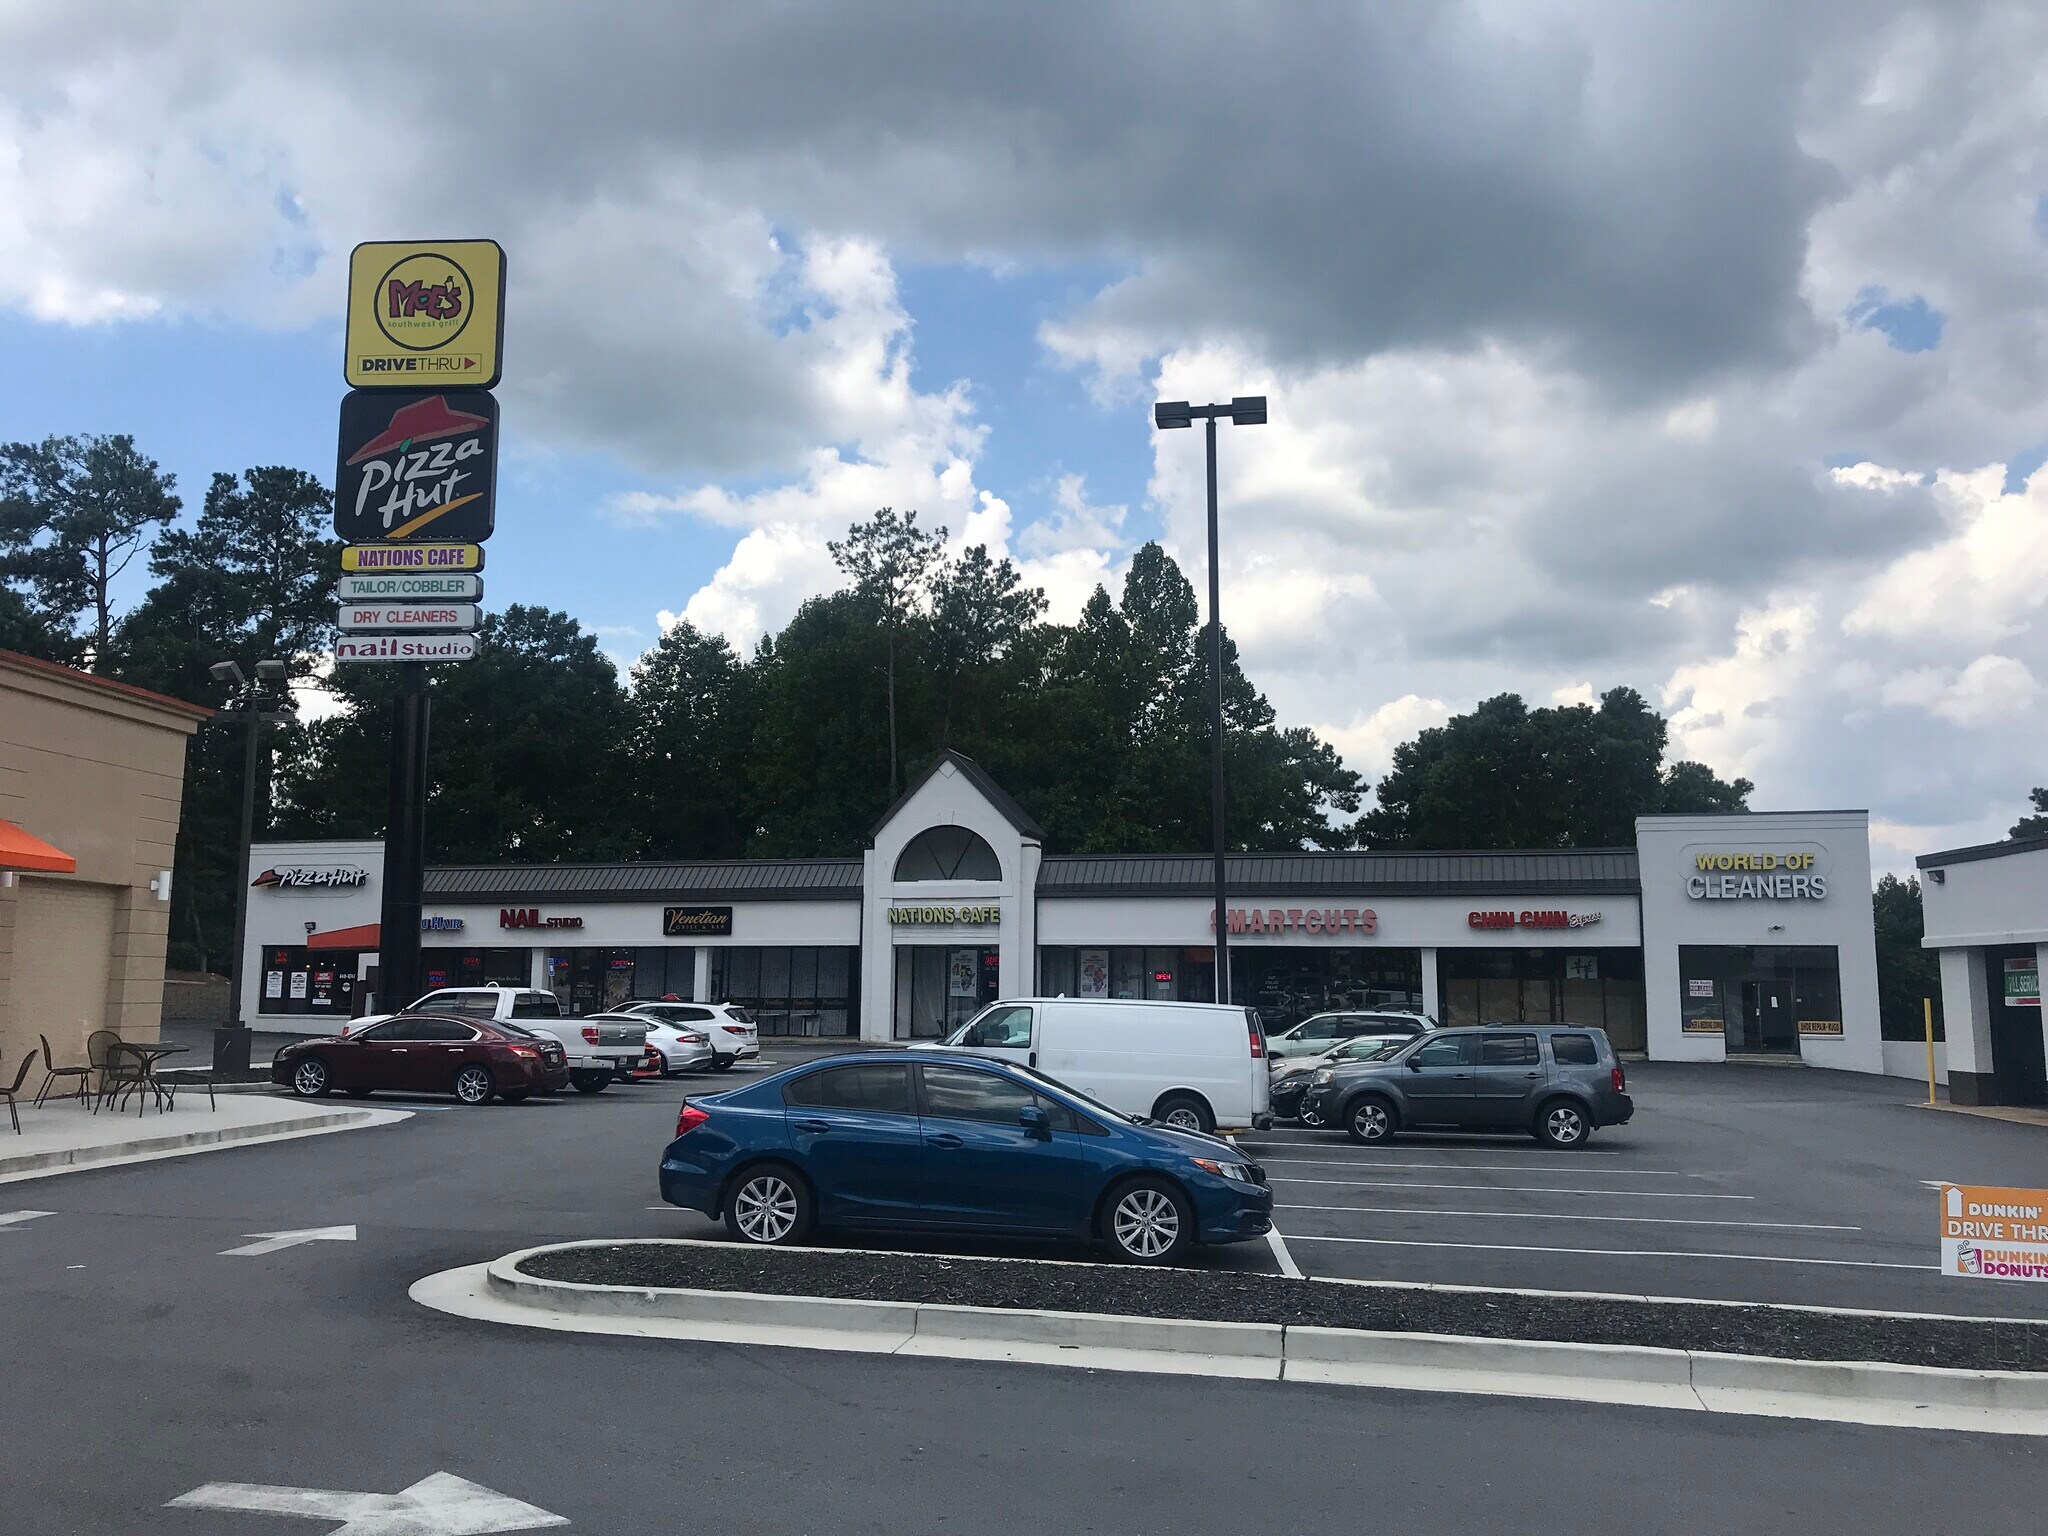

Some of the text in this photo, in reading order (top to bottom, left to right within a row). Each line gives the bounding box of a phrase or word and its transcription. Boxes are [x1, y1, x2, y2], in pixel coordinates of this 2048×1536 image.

[387, 319, 459, 328] southwest grill
[355, 438, 485, 516] Pizza
[377, 469, 472, 528] Hut
[358, 548, 465, 567] NATIONS CAFE
[351, 580, 465, 593] TAILOR/COBBLER
[353, 610, 458, 624] DRY CLEANERS
[337, 638, 398, 657] nail
[1696, 852, 1816, 871] WORLD OF
[279, 868, 369, 887] Pizza Hut
[1686, 874, 1828, 900] CLEANERS
[500, 908, 584, 928] NAIL STUDIO
[666, 908, 729, 933] Venetian
[888, 907, 1000, 923] NATIONS CAFE
[1468, 910, 1602, 929] CHIN CHIN Express
[1968, 1202, 2043, 1219] DUNKIN'
[1947, 1220, 2004, 1238] DRIVE
